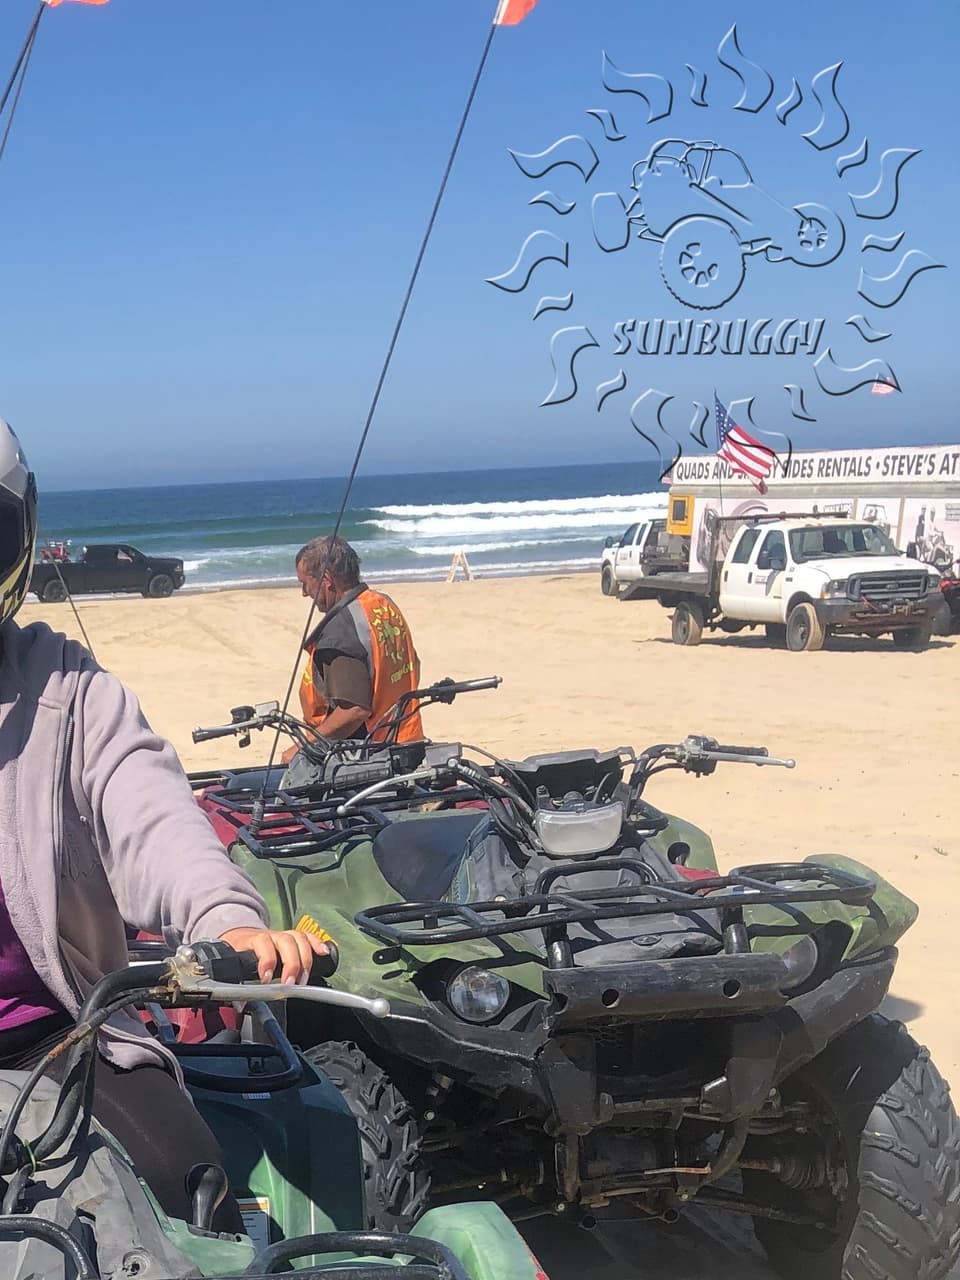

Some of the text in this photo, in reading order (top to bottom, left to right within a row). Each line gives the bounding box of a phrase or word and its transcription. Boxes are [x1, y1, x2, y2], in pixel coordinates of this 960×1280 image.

[676, 461, 709, 481] QUADS
[711, 461, 734, 480] AND
[781, 458, 814, 479] SIDES
[817, 455, 872, 478] RENTALS
[881, 454, 936, 477] STEVE'S
